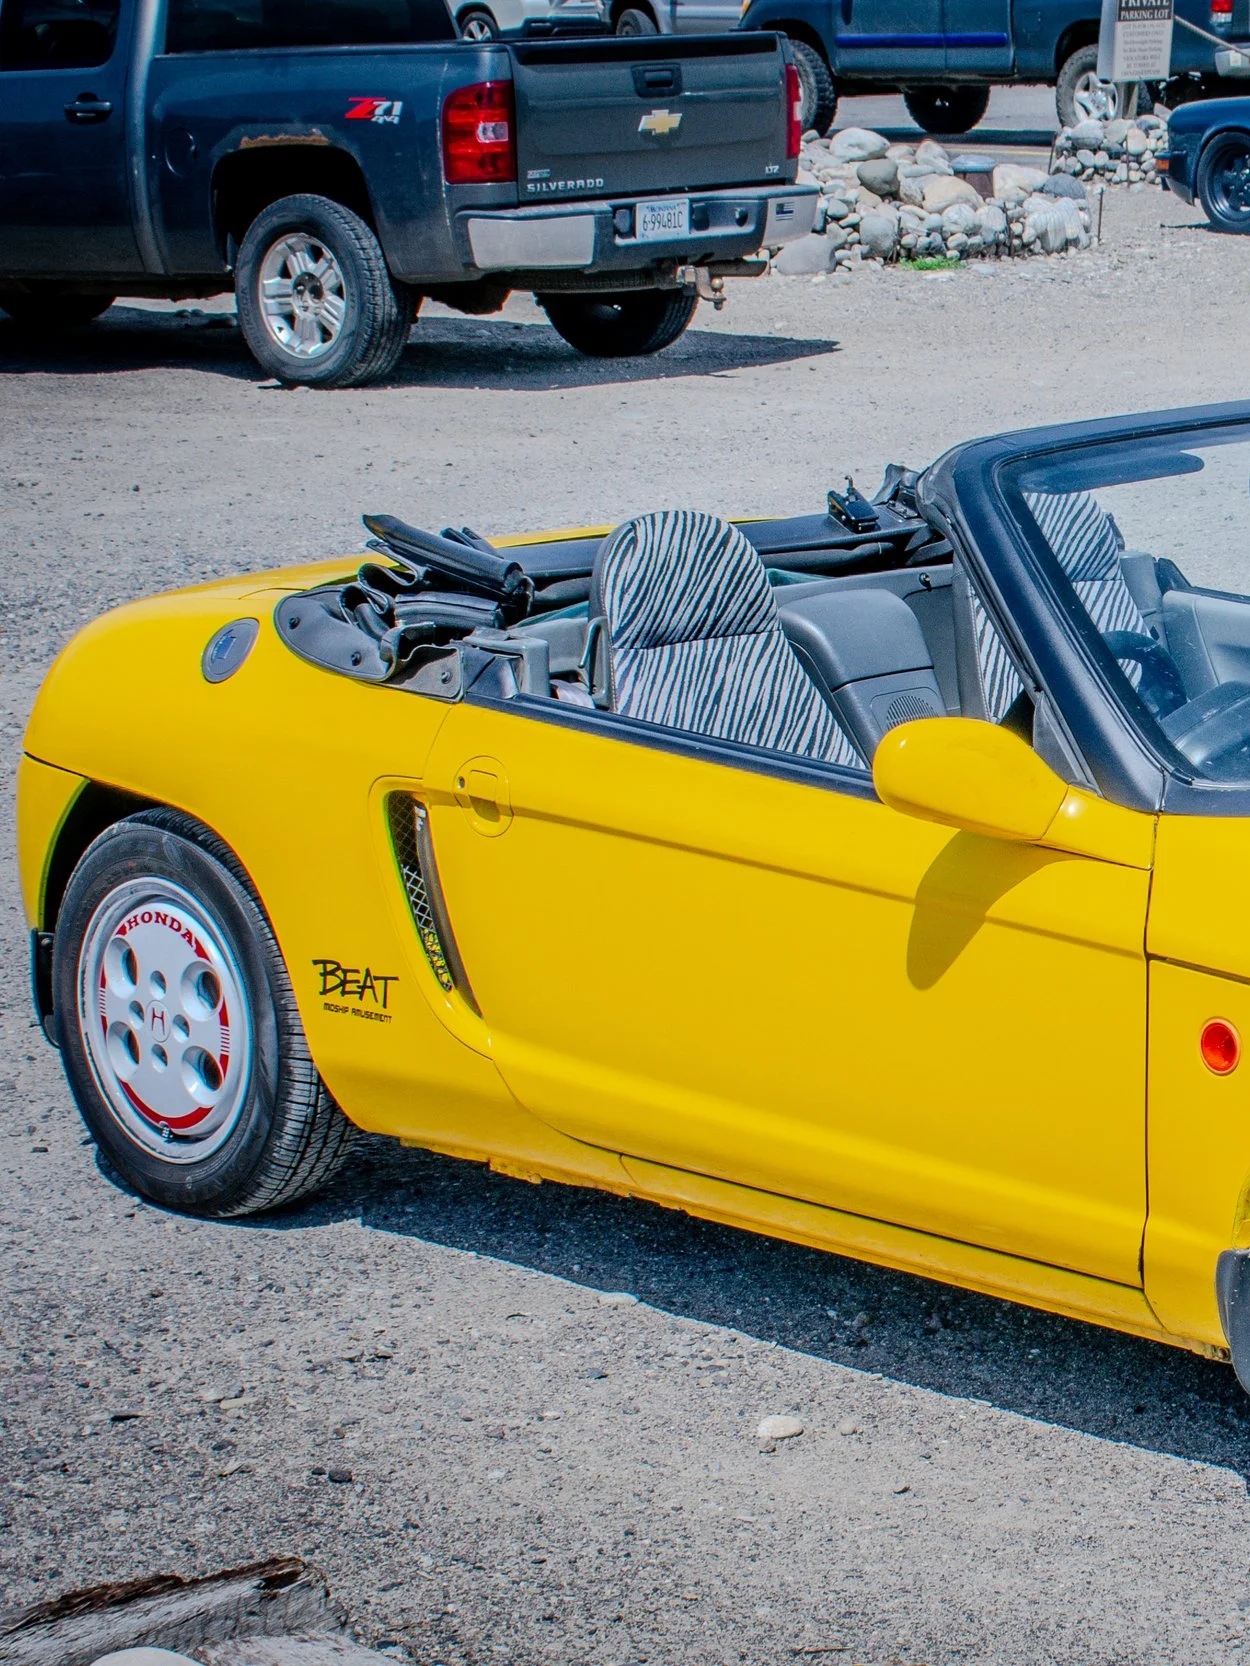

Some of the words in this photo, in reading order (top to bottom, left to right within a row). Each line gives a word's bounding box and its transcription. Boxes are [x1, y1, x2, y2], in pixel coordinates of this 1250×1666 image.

[1120, 10, 1154, 20] PARKING
[1154, 9, 1169, 19] LOT
[345, 97, 403, 119] Z71
[526, 178, 604, 193] SILVERADO
[127, 911, 194, 948] HONDA
[312, 959, 399, 1009] BEAT
[351, 1007, 392, 1023] AMUSEMENT
